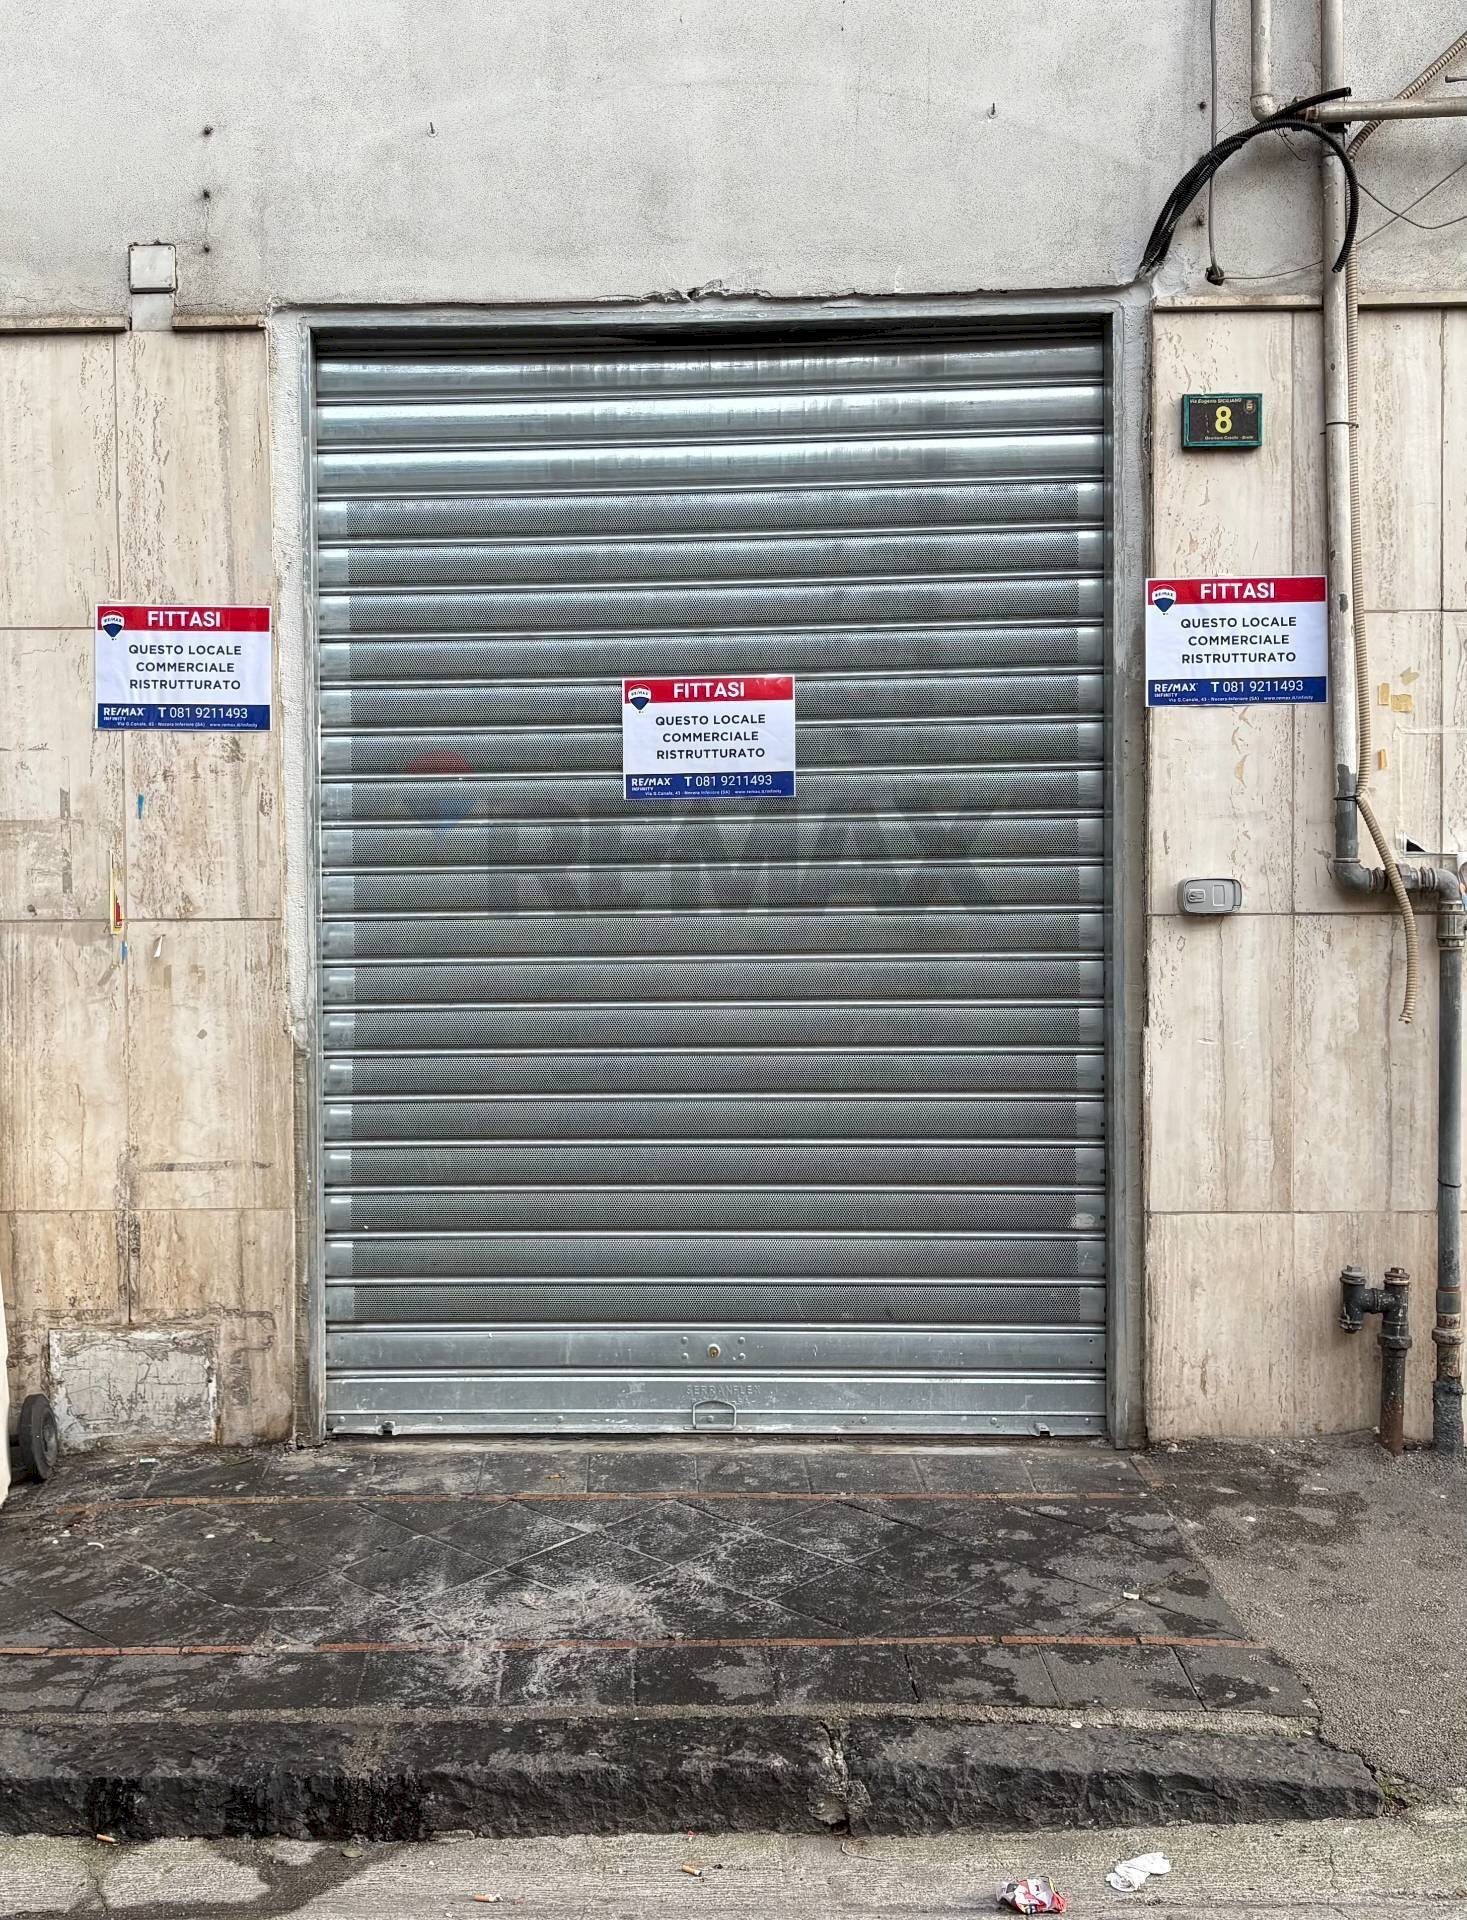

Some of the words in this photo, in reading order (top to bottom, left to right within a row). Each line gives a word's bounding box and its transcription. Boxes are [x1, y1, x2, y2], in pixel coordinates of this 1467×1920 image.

[1215, 405, 1232, 434] 8
[1200, 582, 1275, 599] FITTASI
[103, 616, 122, 624] RE/MAX
[147, 610, 221, 628] FITTASI
[1180, 617, 1238, 629] QUESTO
[1242, 616, 1297, 627] LOCALE
[1188, 634, 1289, 646] COMMERCIALE
[128, 644, 184, 656] QUESTO
[188, 645, 242, 656] LOCALE
[1181, 652, 1297, 664] RISTRUTTURATO
[136, 661, 235, 673] COMMERCIALE
[129, 679, 241, 690] RISTRUTTURATO
[673, 681, 745, 699] FITTASI
[1154, 683, 1197, 693] RE/MAX
[1210, 681, 1220, 693] T
[1222, 681, 1245, 693] 081
[1249, 680, 1304, 692] 9211493
[103, 707, 145, 717] RE/MAX
[157, 707, 167, 718] T
[169, 707, 191, 719] 081
[195, 707, 248, 719] 9211493
[655, 715, 709, 726] QUESTO
[713, 714, 766, 725] LOCALE
[662, 731, 759, 743] COMMERCIALE
[656, 748, 765, 759] RISTRUTTURATO
[631, 777, 671, 787] RE/MAX
[684, 776, 693, 787] T
[695, 776, 716, 787] 081
[720, 775, 773, 786] 9211493
